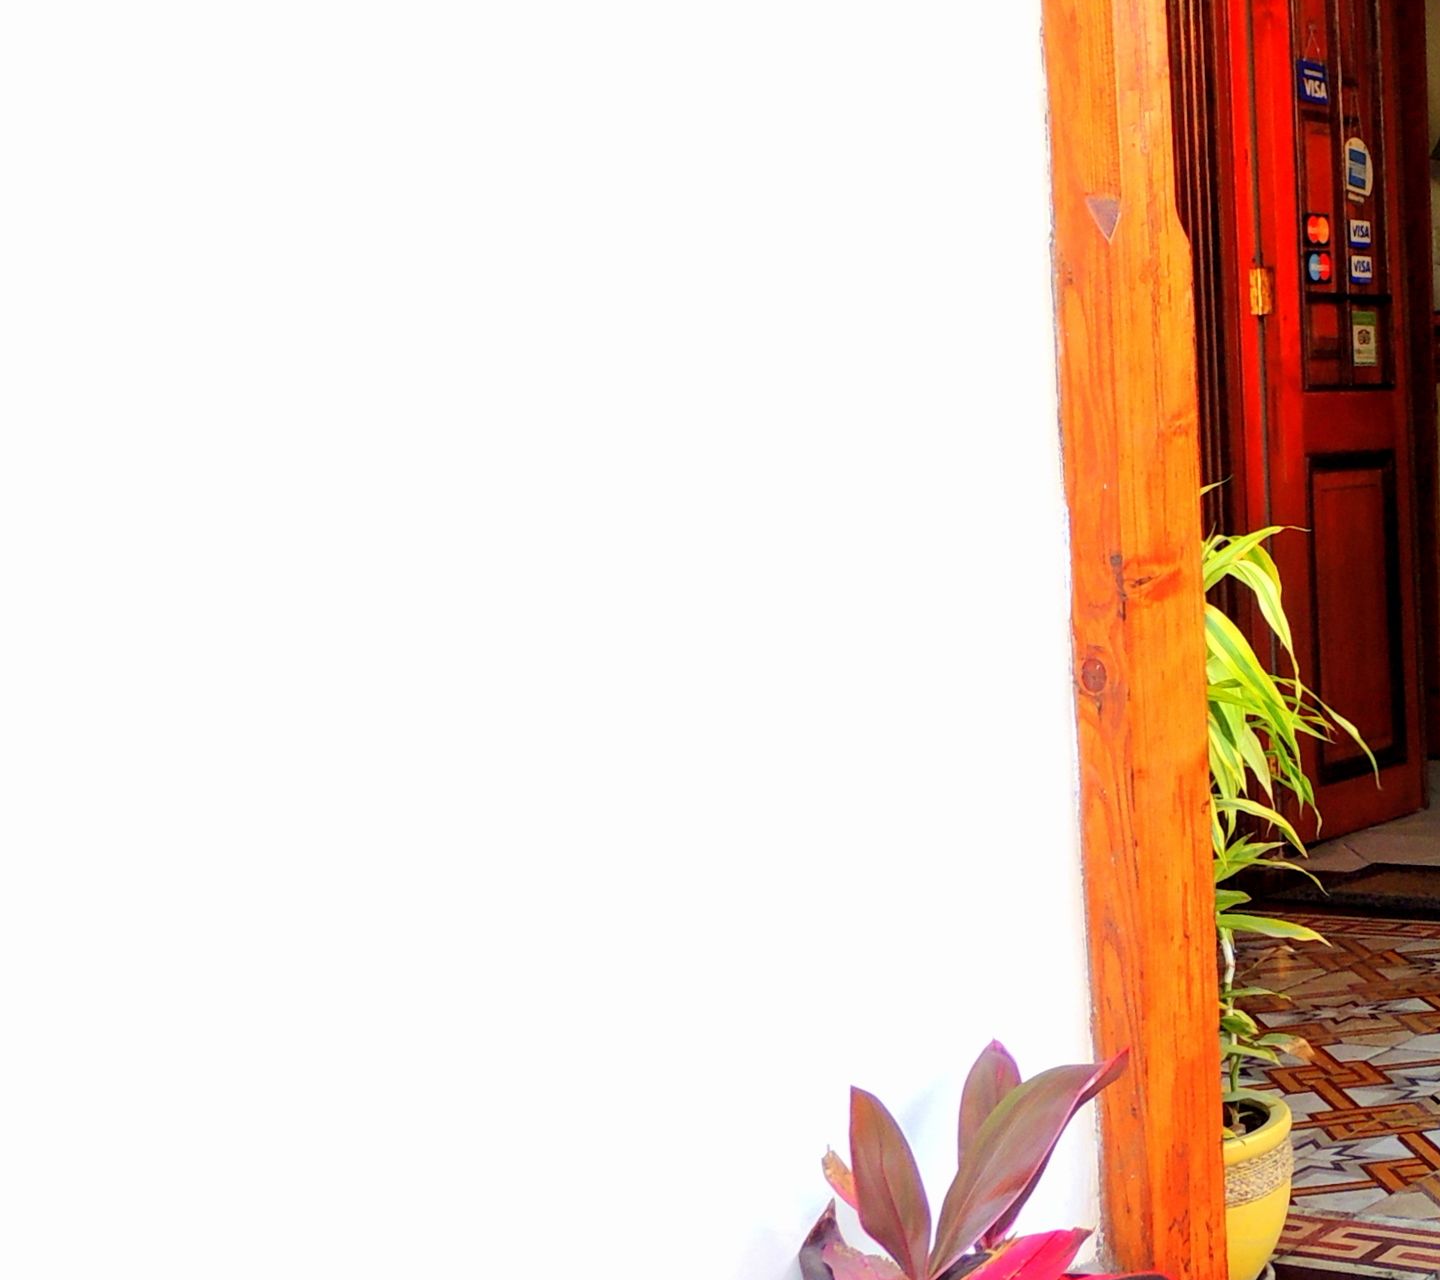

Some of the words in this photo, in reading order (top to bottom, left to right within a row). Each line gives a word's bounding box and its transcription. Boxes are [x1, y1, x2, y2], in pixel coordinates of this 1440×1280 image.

[1303, 77, 1328, 99] VISA
[1353, 224, 1370, 239] VISA
[1354, 260, 1371, 273] VISA
